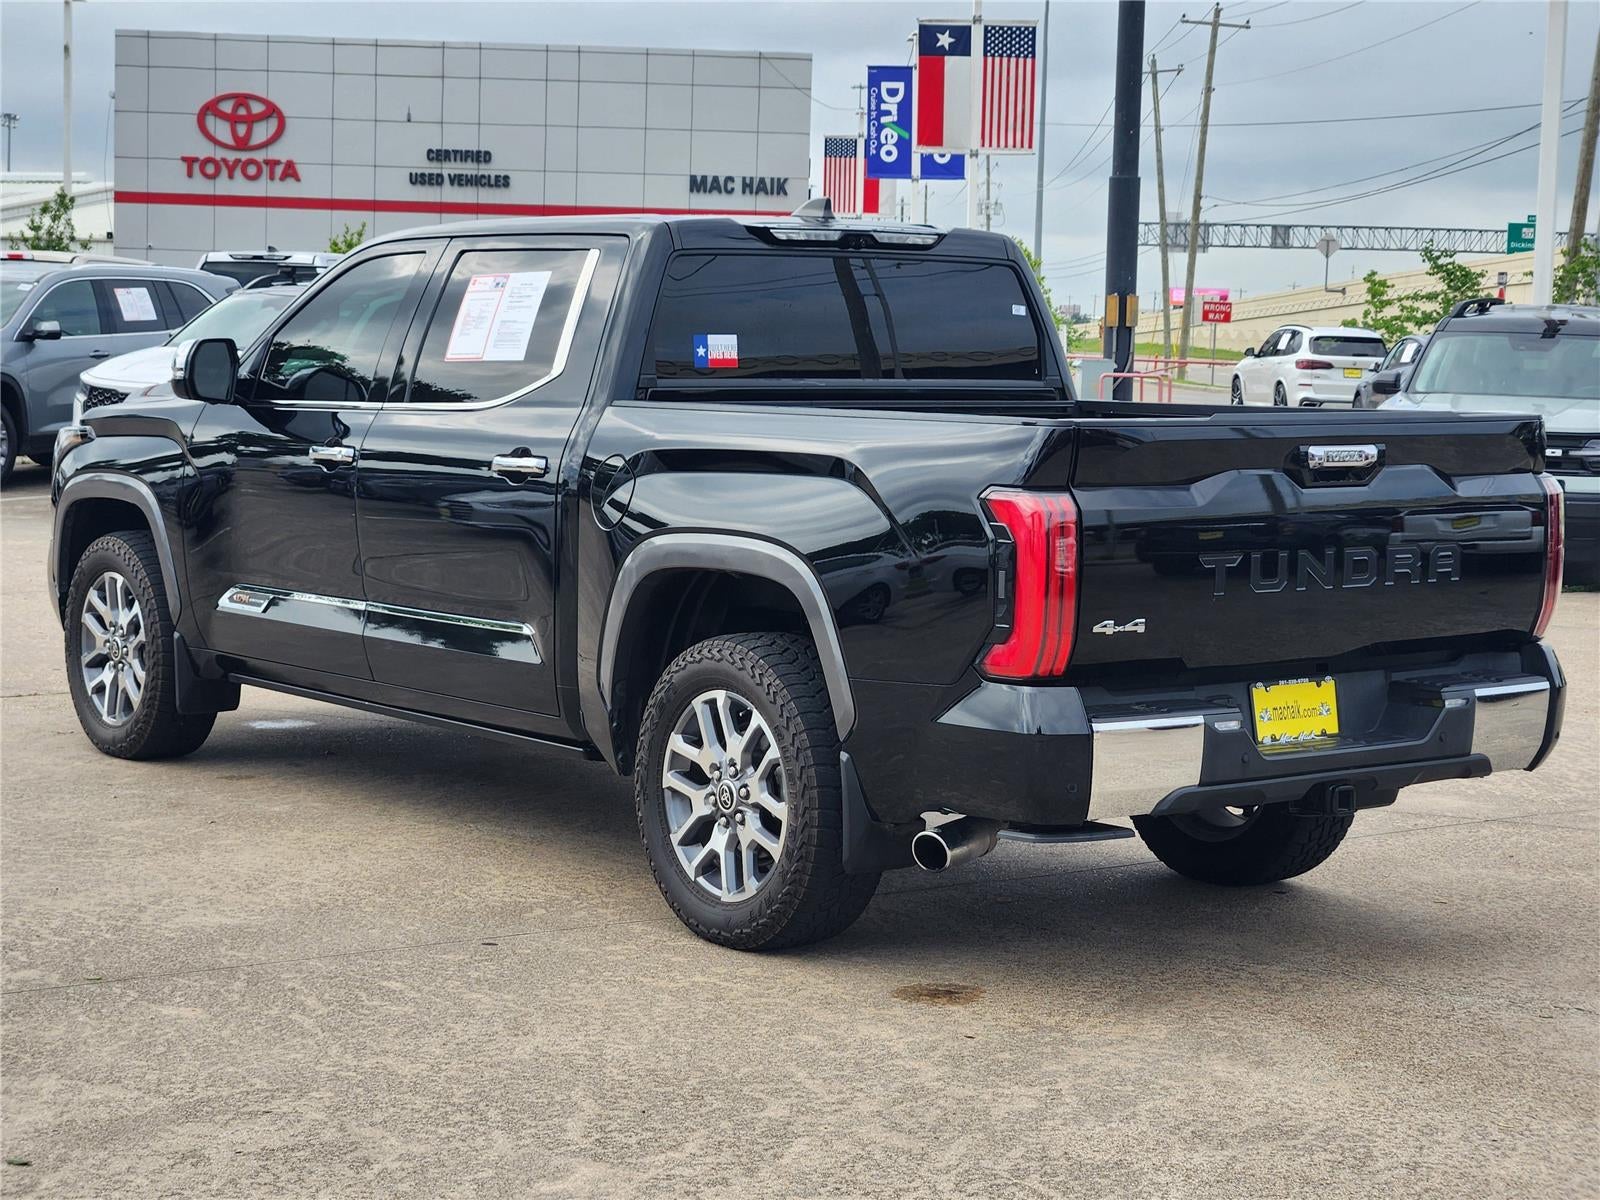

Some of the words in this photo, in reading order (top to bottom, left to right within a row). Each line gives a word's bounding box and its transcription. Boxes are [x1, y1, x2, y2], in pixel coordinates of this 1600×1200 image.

[870, 87, 878, 110] Cruise
[870, 120, 878, 139] Cash
[880, 81, 909, 163] Driveo
[426, 148, 492, 164] CERTIFIED
[181, 156, 301, 182] TOYOTA
[409, 172, 444, 187] USED
[448, 172, 511, 188] VEHICLES
[690, 175, 735, 195] MAC
[741, 177, 789, 196] HAIK
[1204, 303, 1231, 312] WRONG
[1208, 312, 1225, 320] WAY
[1327, 450, 1364, 462] TOYOTA
[1199, 542, 1462, 596] TUNDRA
[1272, 700, 1318, 721] machaik.com
